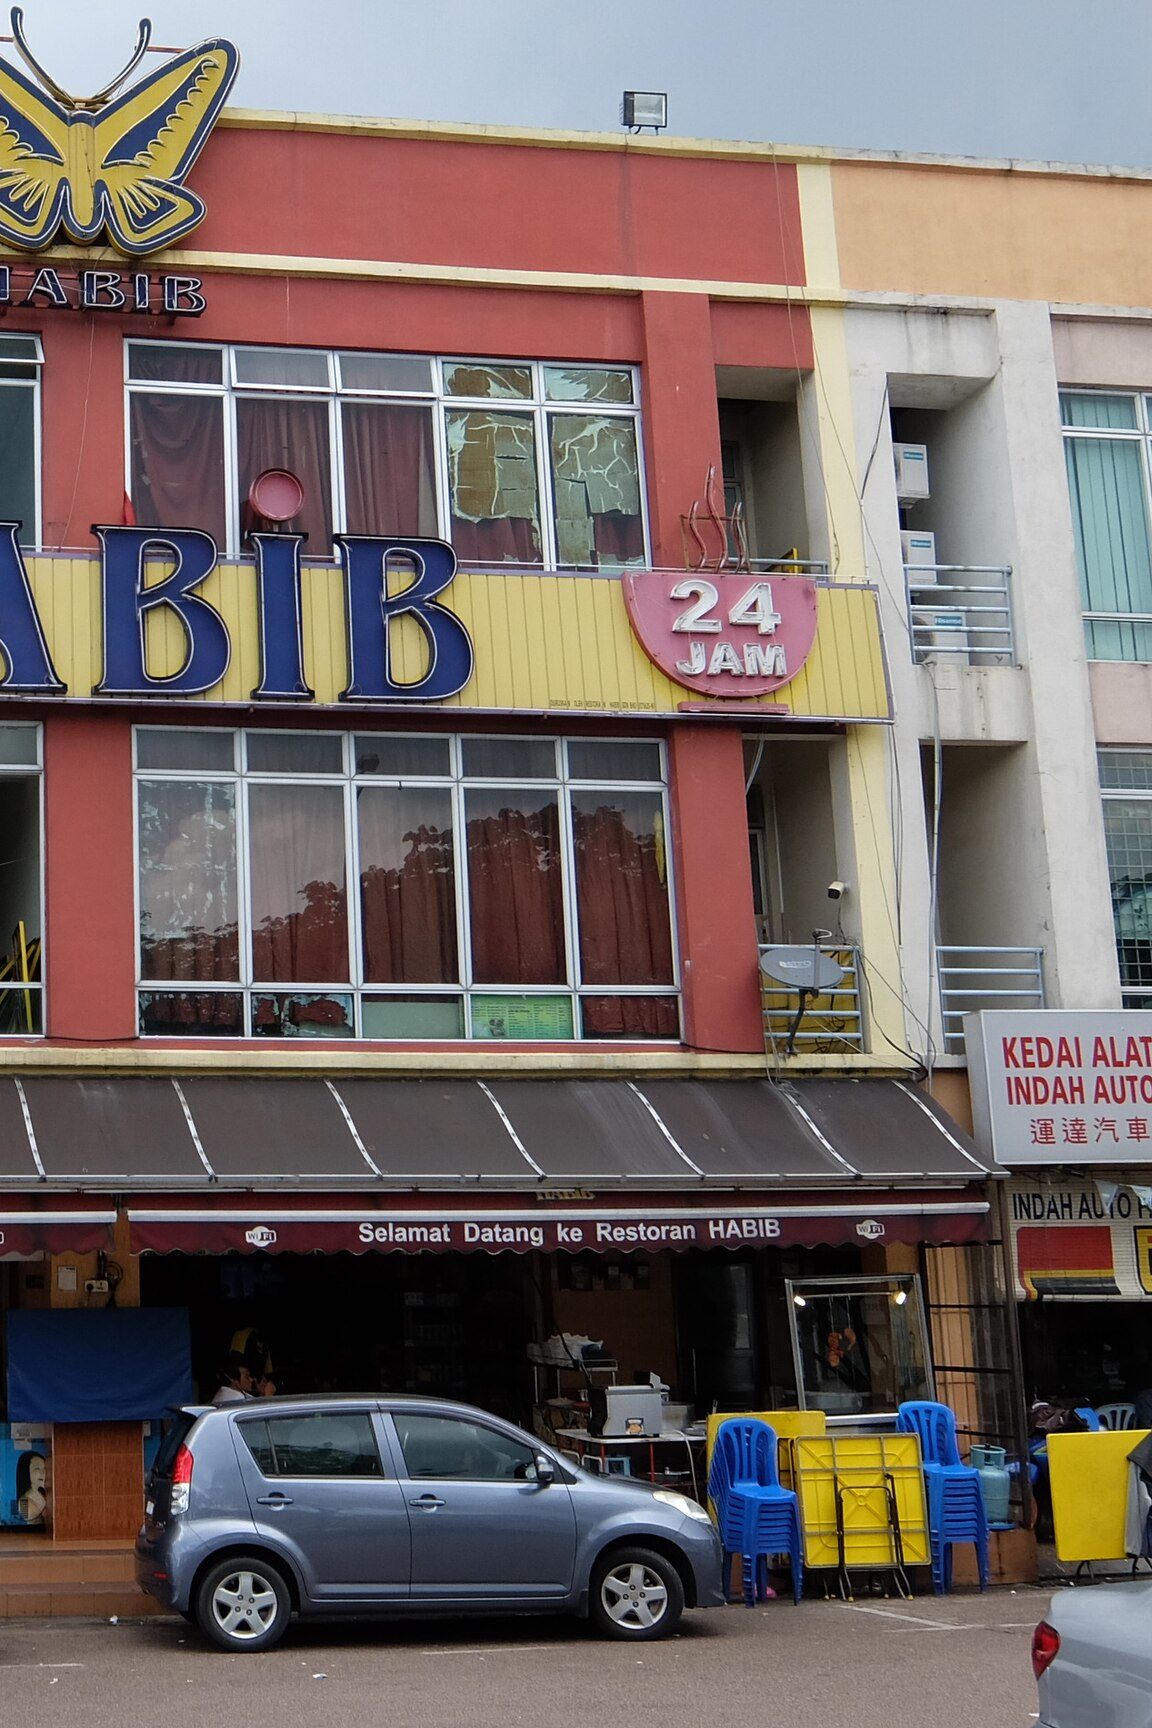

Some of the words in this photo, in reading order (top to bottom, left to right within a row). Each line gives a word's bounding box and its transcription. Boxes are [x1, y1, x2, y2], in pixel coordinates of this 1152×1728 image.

[669, 579, 782, 635] 24
[675, 641, 788, 678] JAM
[1002, 1036, 1084, 1068] KEDAI
[1092, 1036, 1152, 1067] ALAT
[1006, 1076, 1085, 1105] INDAH
[1094, 1075, 1152, 1105] AUTO
[1030, 1116, 1151, 1145] 運達汽車
[1012, 1193, 1073, 1219] INDAH
[359, 1222, 450, 1243] Selamat
[464, 1223, 544, 1247] Datang
[557, 1223, 583, 1242] ke
[596, 1222, 696, 1241] Restoran
[709, 1218, 781, 1239] HABIB
